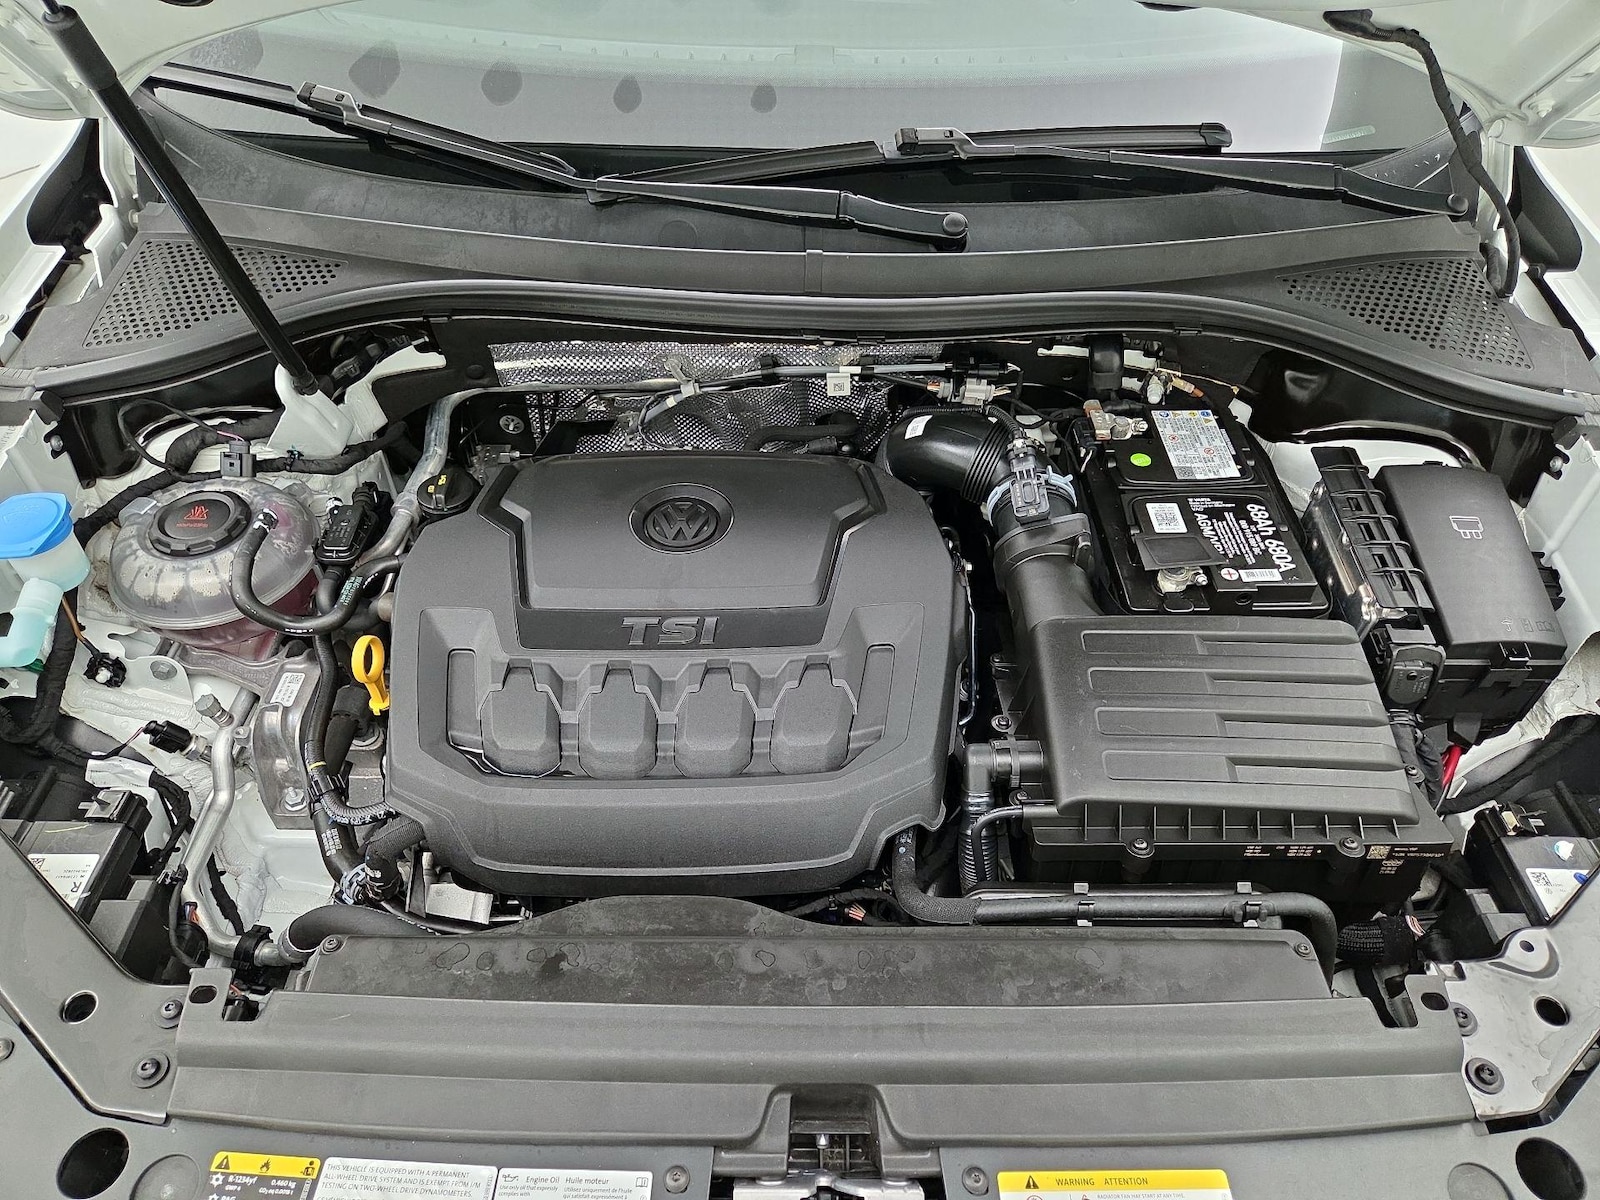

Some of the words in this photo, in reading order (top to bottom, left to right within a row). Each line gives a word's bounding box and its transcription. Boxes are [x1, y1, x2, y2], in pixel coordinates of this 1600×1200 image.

[1246, 503, 1276, 536] 68Ah
[1264, 539, 1296, 573] 680A
[621, 616, 719, 645] TSI
[228, 1174, 258, 1186] R-1234yf
[526, 1176, 549, 1185] Engine
[1055, 1178, 1094, 1186] WARNING
[1104, 1177, 1148, 1186] ATTENTION
[360, 1184, 398, 1193] TWO-WHEEL
